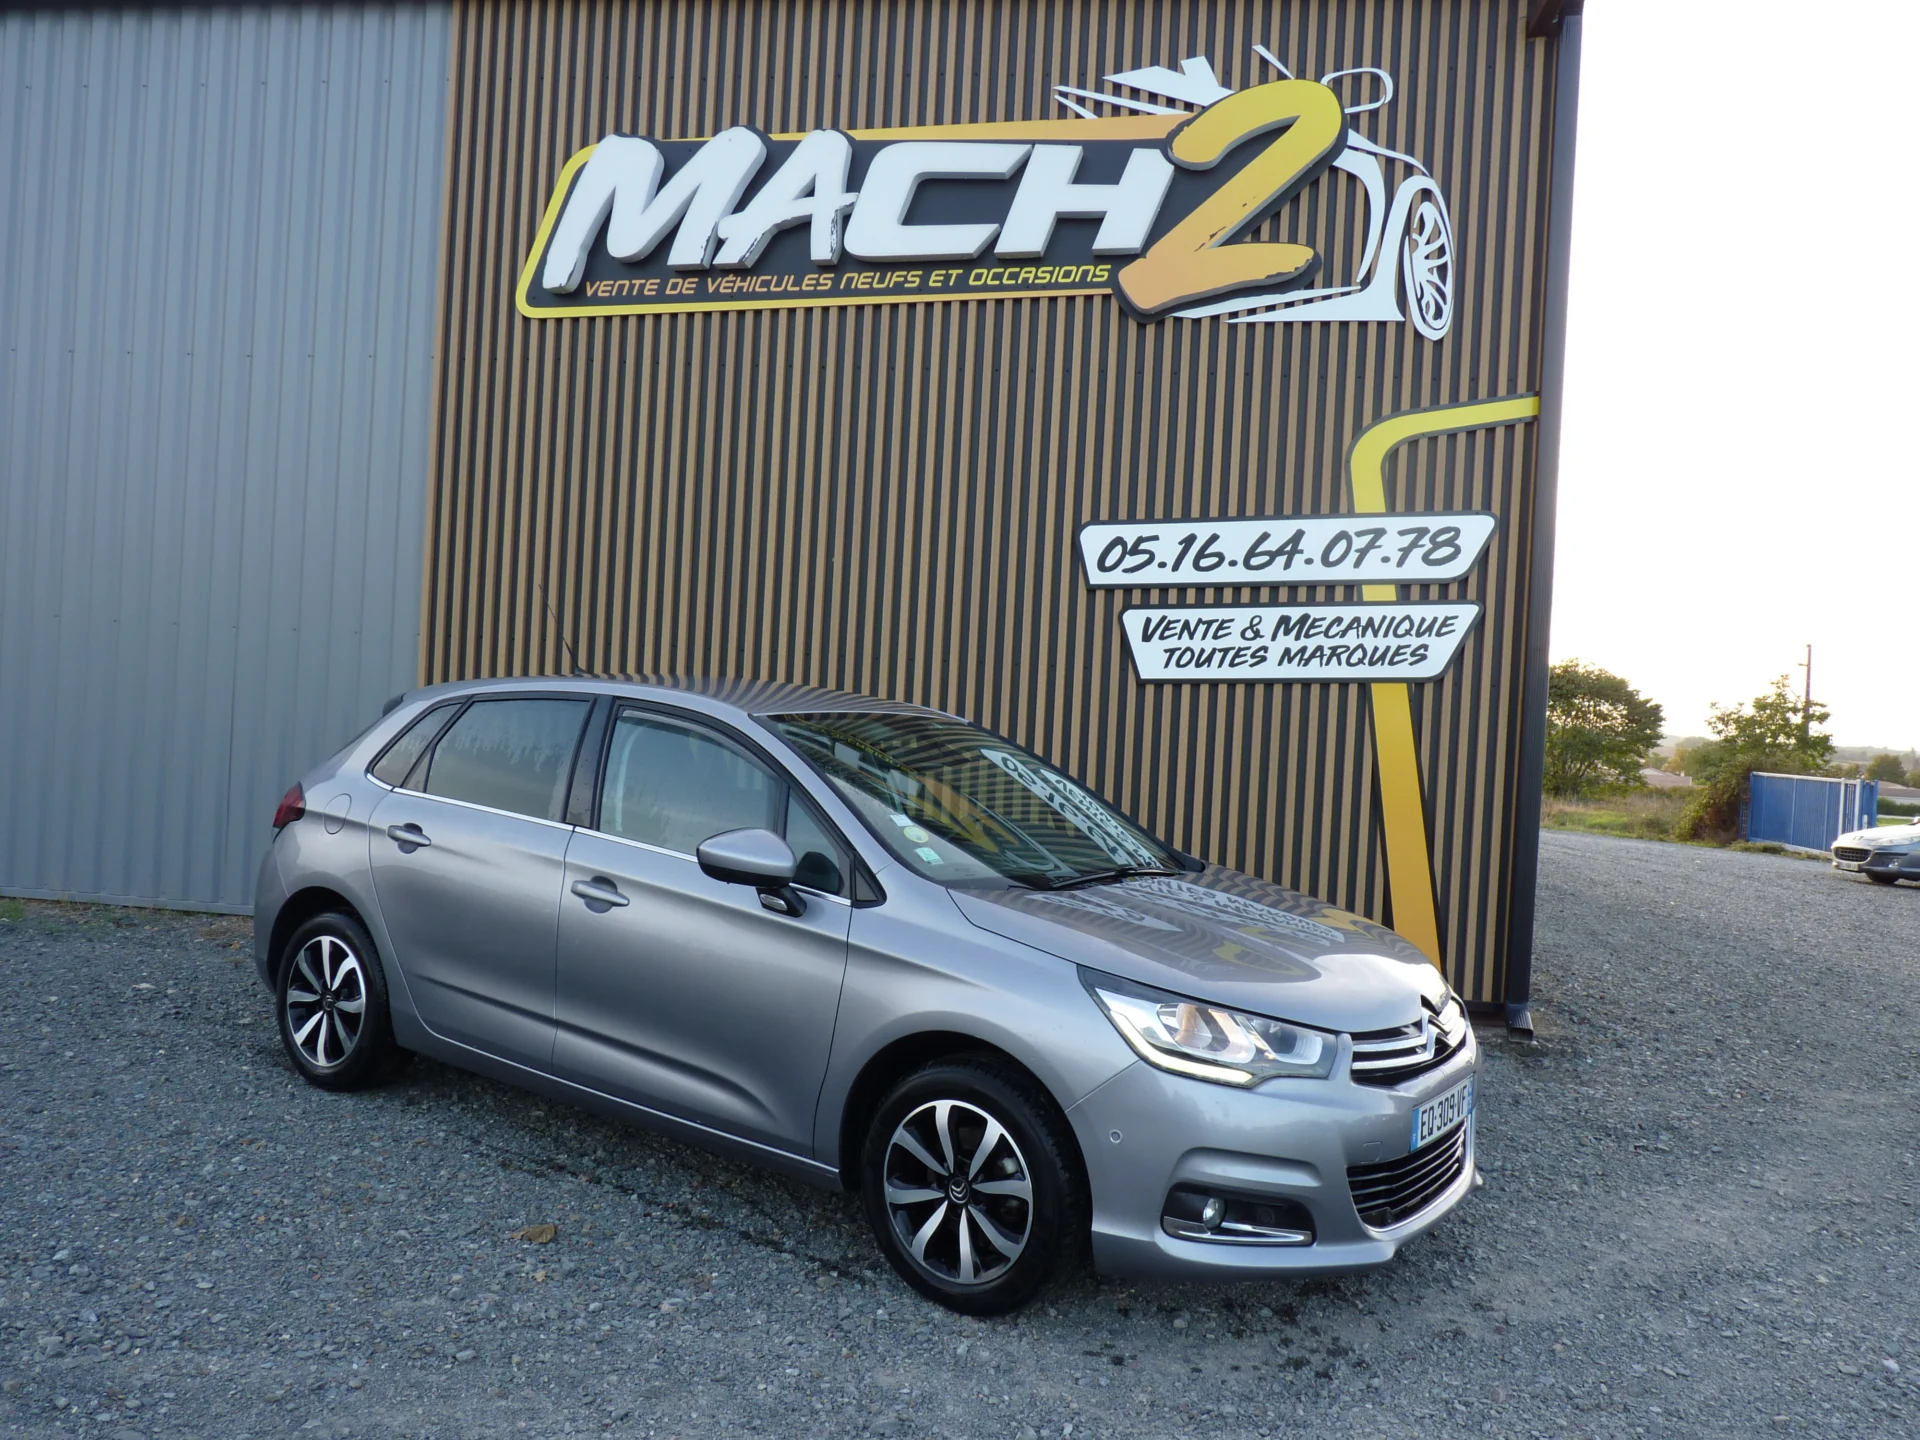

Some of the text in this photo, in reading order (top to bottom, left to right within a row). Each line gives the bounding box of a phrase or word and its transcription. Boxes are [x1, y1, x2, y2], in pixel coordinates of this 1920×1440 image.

[542, 78, 1343, 315] MACH 2
[586, 264, 1112, 297] VENTE DE VÉHICULES NEUFS ET OCCASIONS
[1096, 525, 1463, 574] 05.16.64.07.78
[1141, 612, 1460, 643] VENTE & MECANIQUE
[1162, 642, 1430, 669] TOUTES MARQUES
